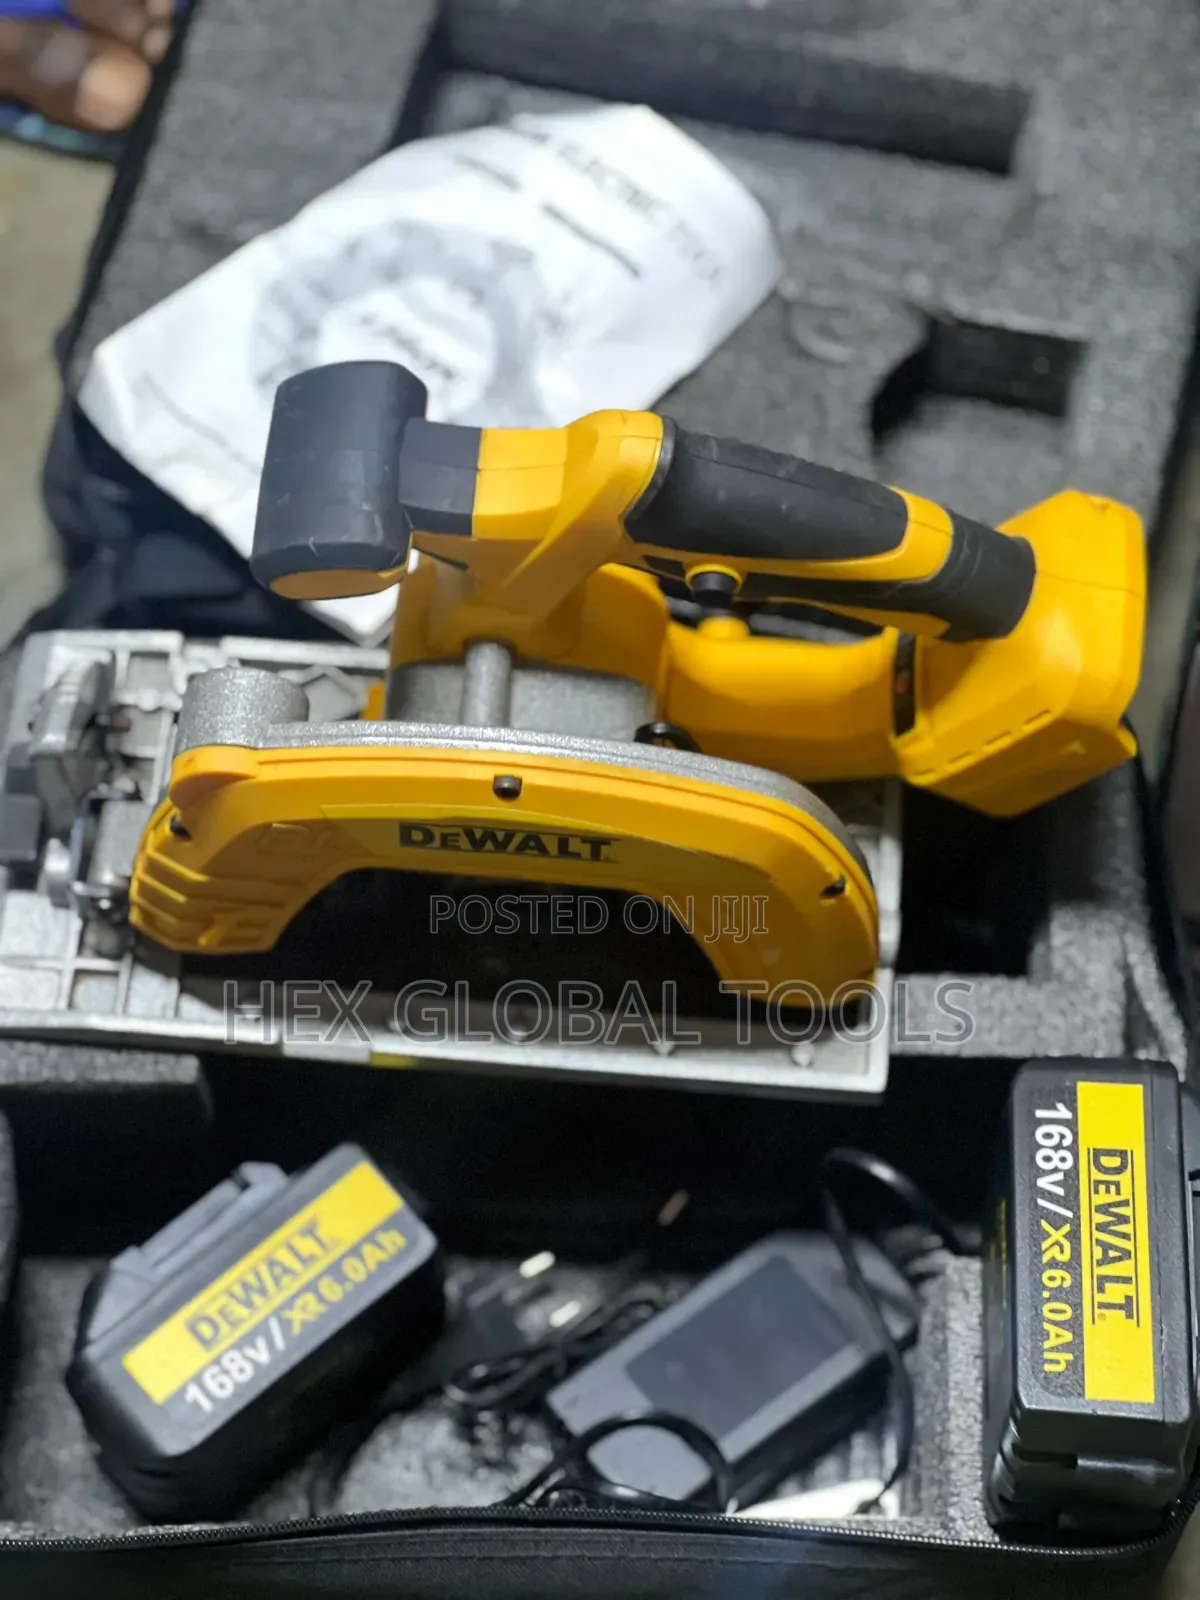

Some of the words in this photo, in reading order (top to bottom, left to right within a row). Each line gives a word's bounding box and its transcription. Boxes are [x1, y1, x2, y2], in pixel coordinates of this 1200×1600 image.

[399, 824, 613, 861] DEWALT
[182, 1215, 330, 1352] DEWALT
[1092, 1147, 1135, 1321] DEWALT
